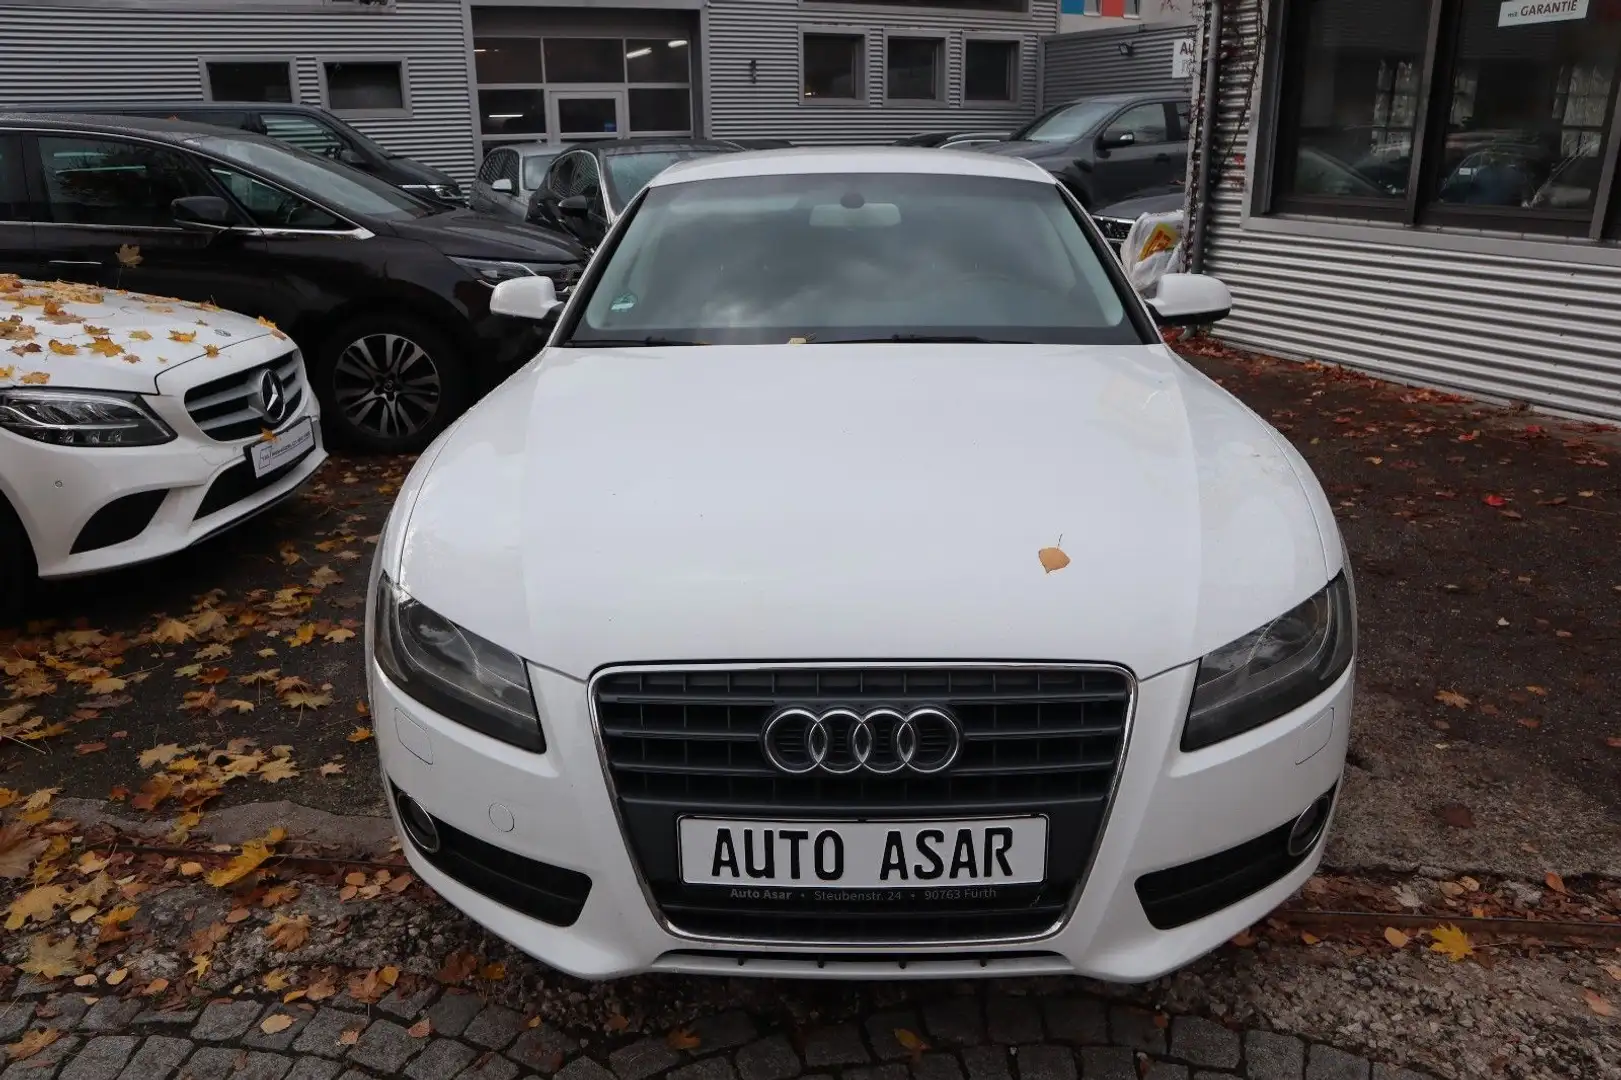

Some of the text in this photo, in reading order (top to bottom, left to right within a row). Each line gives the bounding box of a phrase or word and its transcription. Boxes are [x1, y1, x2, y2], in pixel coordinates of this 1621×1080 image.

[1520, 1, 1577, 17] GARANTIE
[711, 827, 1014, 881] AUTO ASAR
[730, 888, 997, 901] Auto Asar Steubenstr. 24 90763 Fürth
